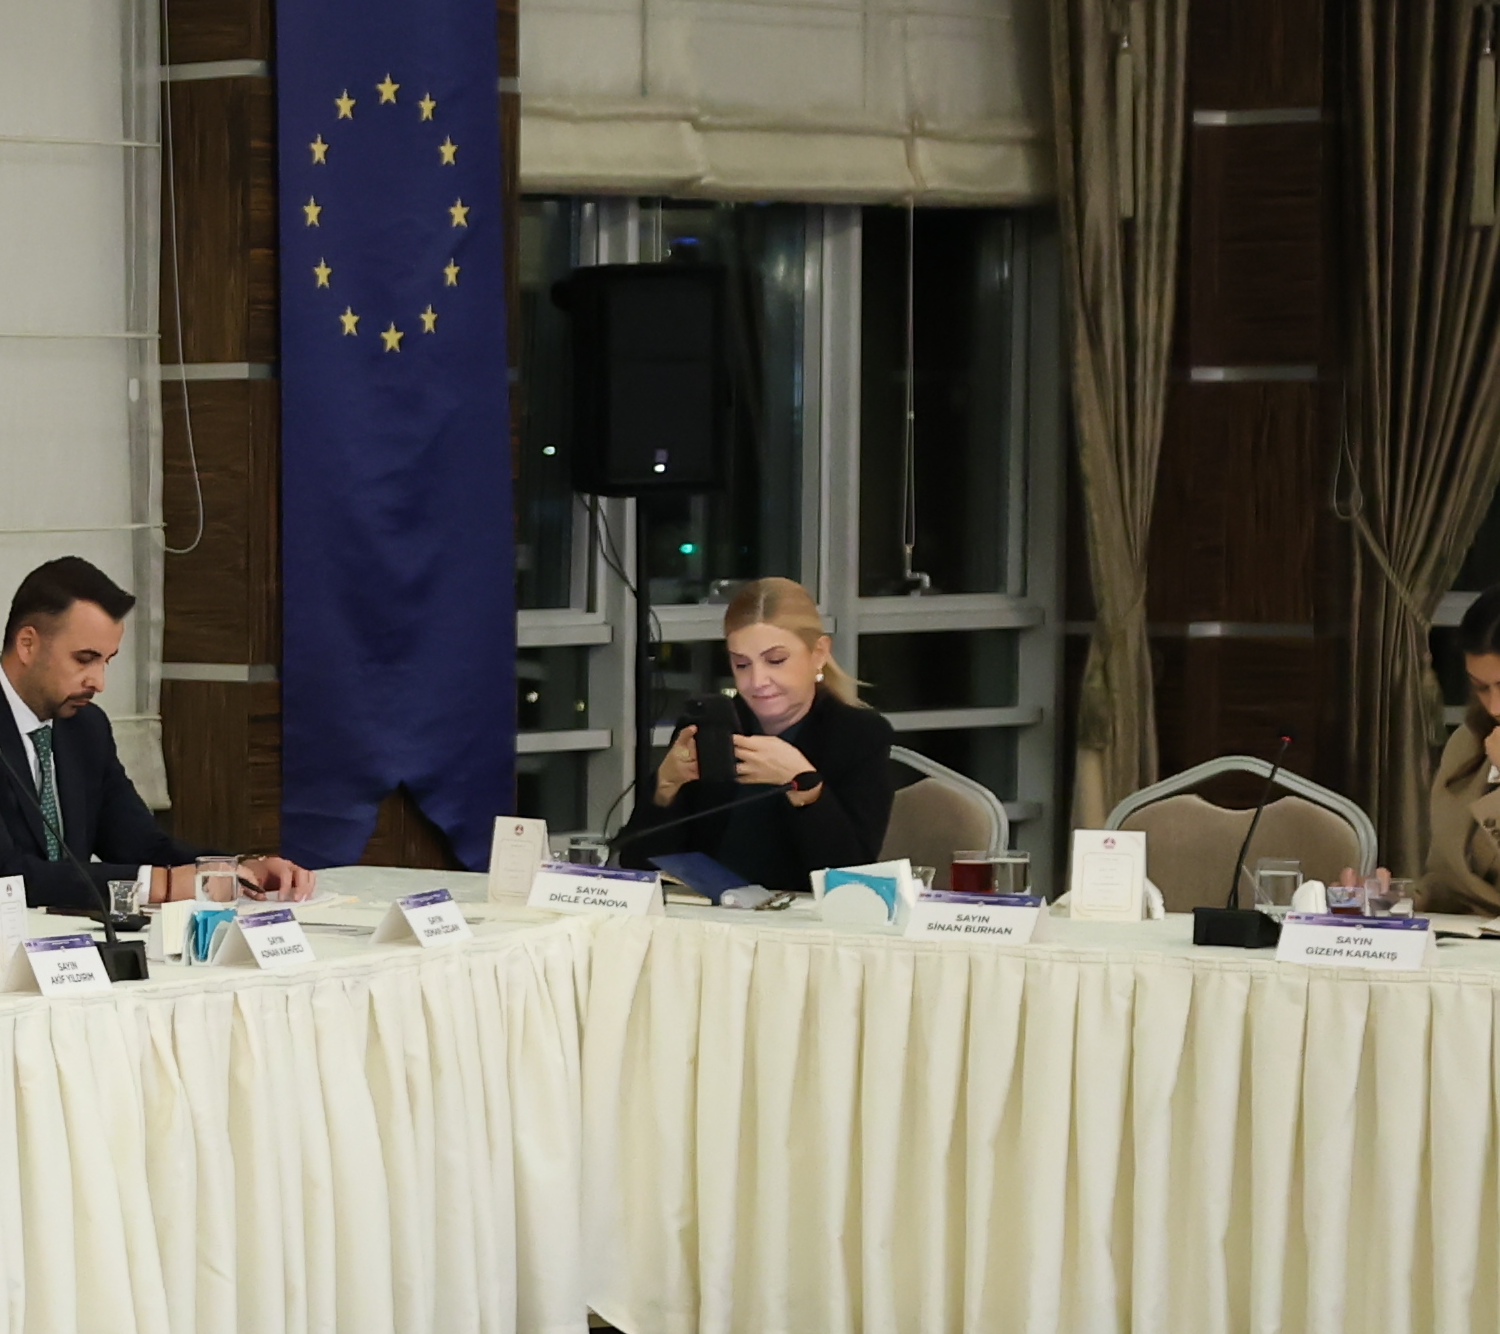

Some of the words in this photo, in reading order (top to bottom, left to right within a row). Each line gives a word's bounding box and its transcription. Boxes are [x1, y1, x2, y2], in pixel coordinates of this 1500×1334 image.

[576, 886, 609, 896] SAYIN
[583, 897, 628, 908] CANOVA
[956, 914, 990, 924] SAYIN
[964, 924, 1013, 935] BURHAN
[1336, 936, 1373, 946] SAYIN
